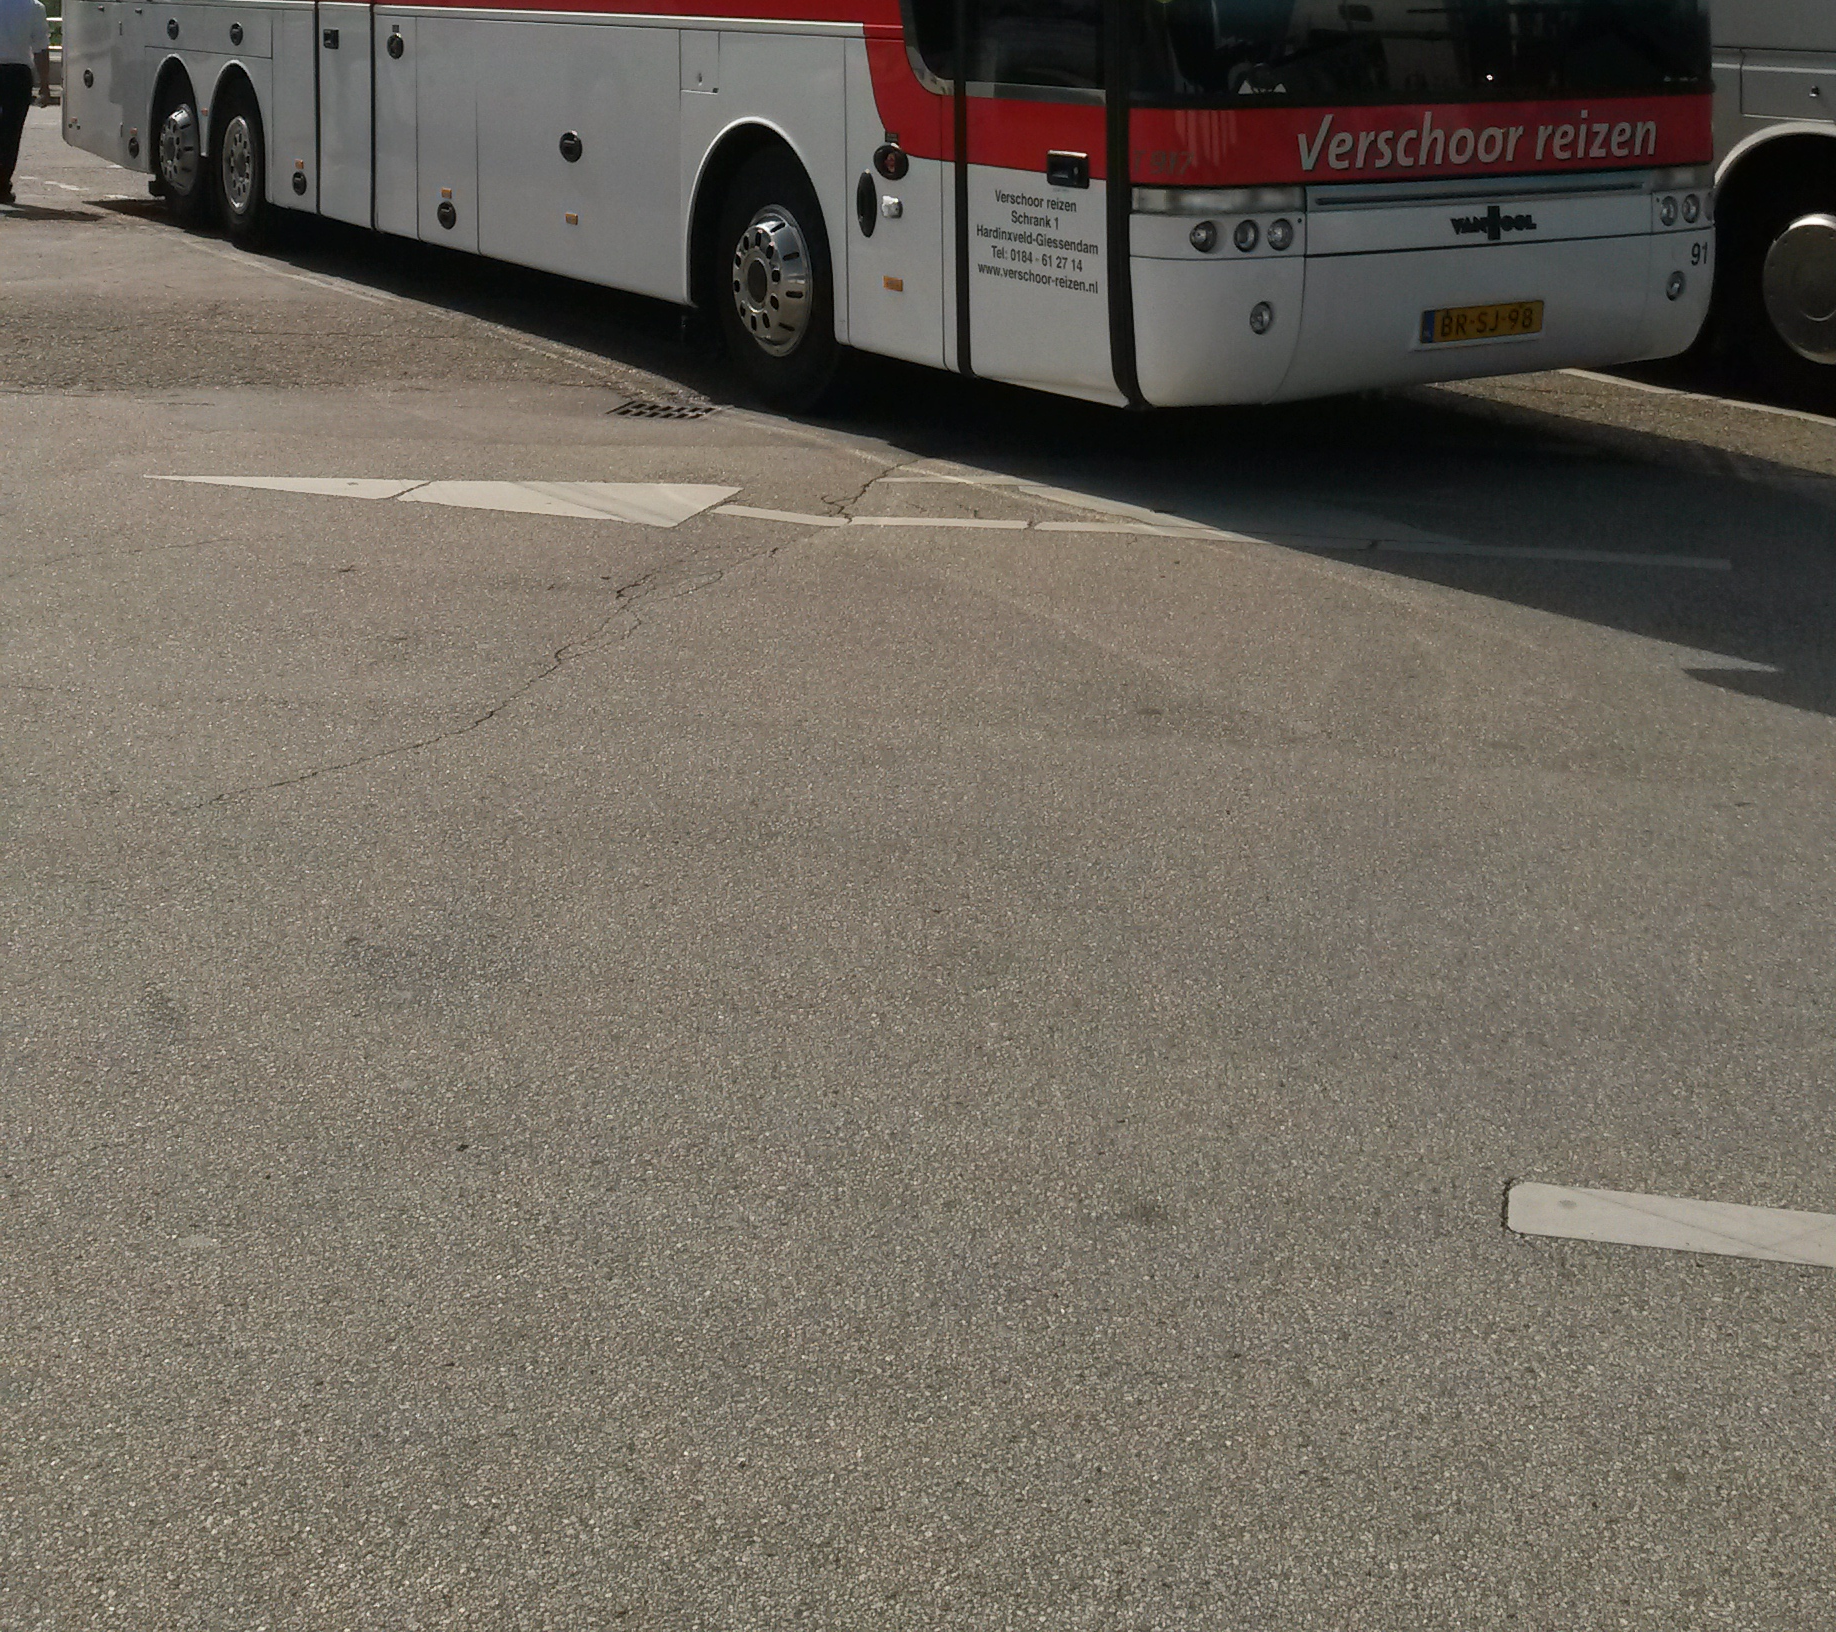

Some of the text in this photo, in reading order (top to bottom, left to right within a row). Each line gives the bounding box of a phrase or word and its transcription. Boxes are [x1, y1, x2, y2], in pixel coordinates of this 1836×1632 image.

[1297, 109, 1657, 171] Verschoor reizen
[994, 189, 1077, 212] Verschoor reizen
[1011, 210, 1059, 230] Schrank 1
[976, 224, 1099, 255] Hardinxveld-Giessendam
[991, 245, 1008, 261] Tel:
[1010, 249, 1033, 264] 0184
[1041, 253, 1052, 268] 61
[1056, 256, 1068, 270] 27
[1071, 259, 1083, 272] 14
[1691, 241, 1708, 266] 91
[977, 263, 1099, 294] www.verschoor-reizen.nl
